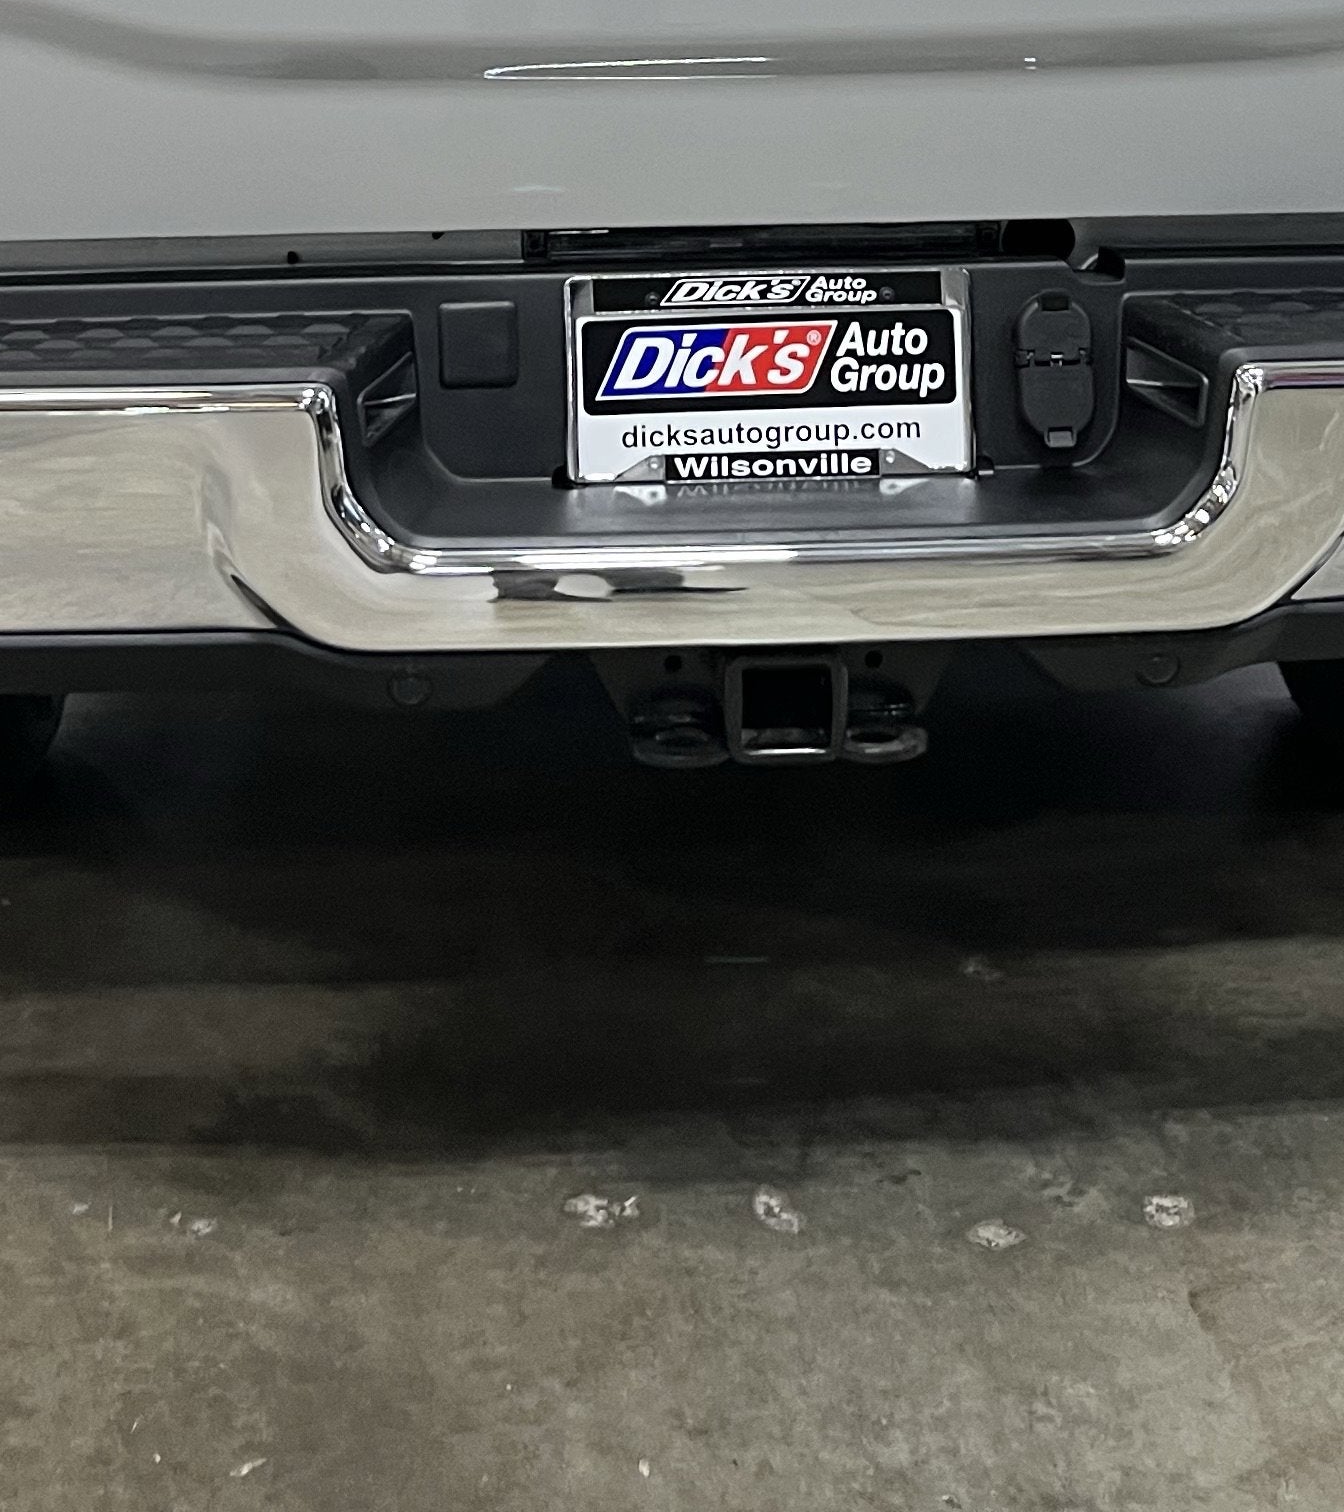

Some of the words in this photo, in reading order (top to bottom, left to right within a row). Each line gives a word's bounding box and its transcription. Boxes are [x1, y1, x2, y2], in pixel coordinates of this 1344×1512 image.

[805, 288, 877, 304] Group
[810, 276, 867, 290] Auto
[836, 321, 928, 357] Auto
[830, 356, 945, 398] Group
[622, 422, 922, 449] dicksautogroup.com
[674, 453, 873, 478] Wilsonville
